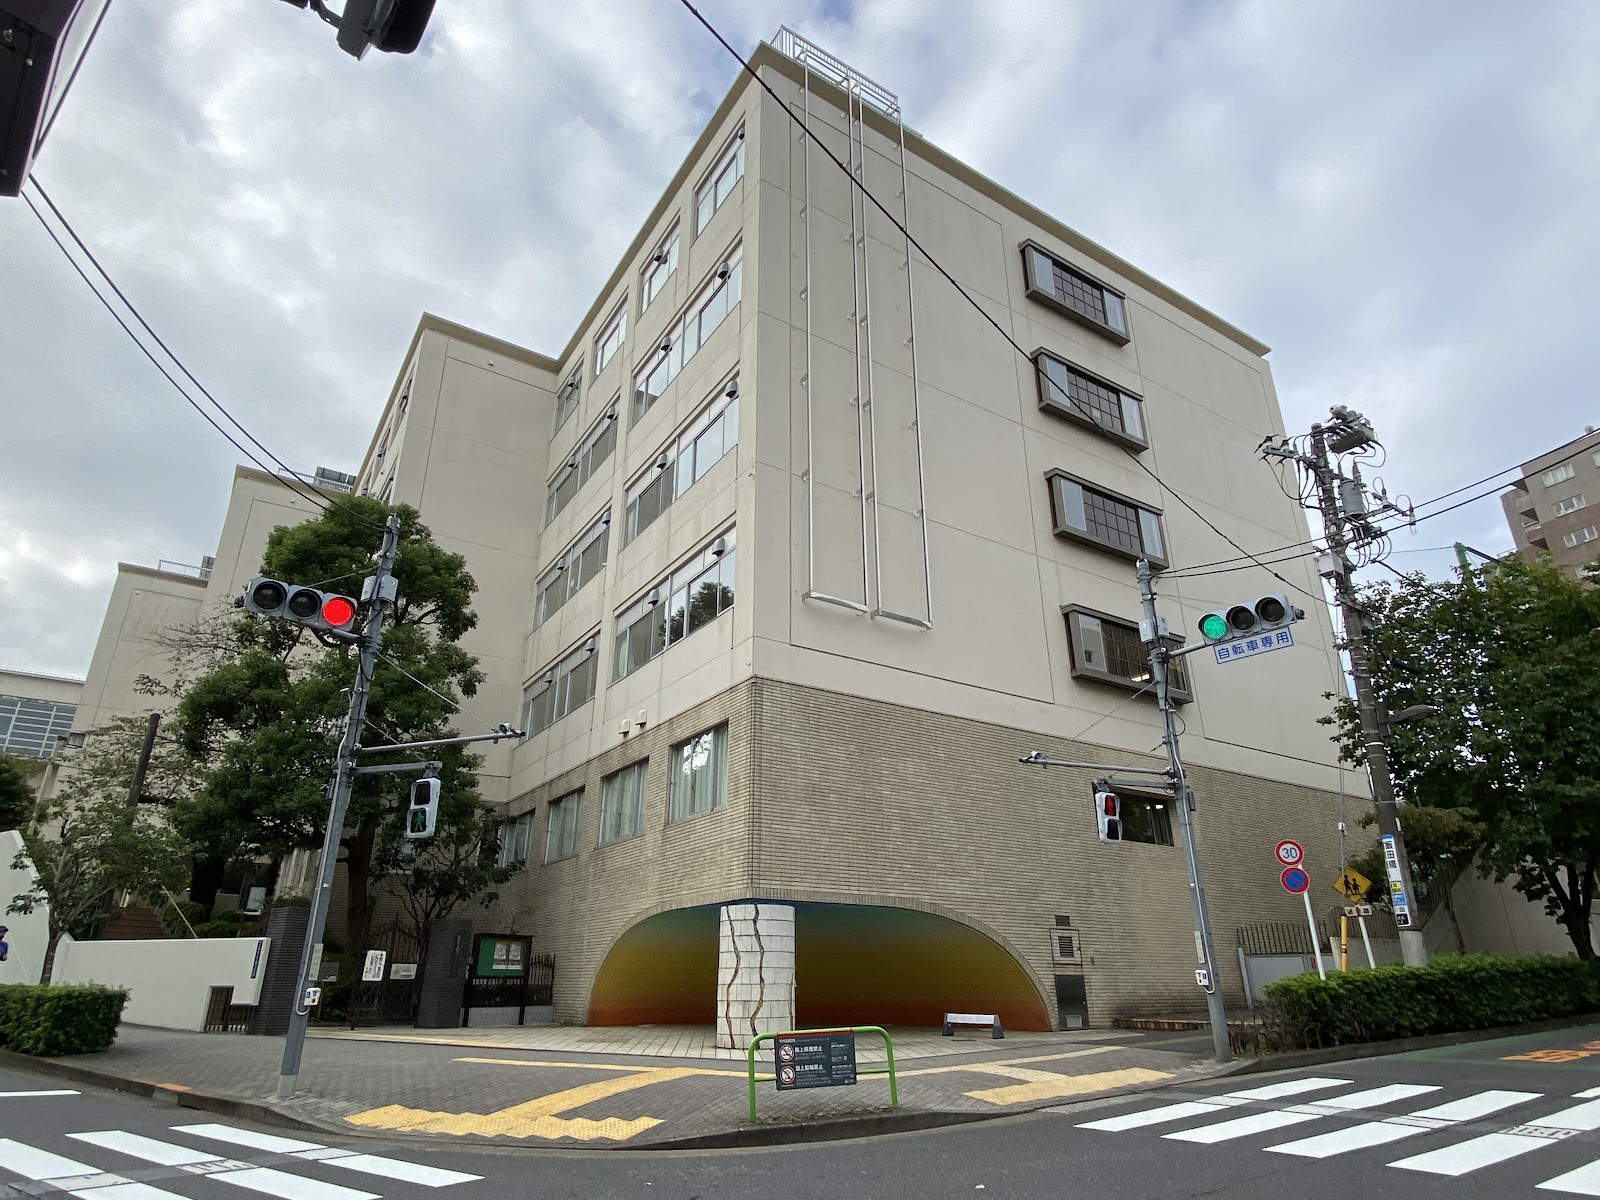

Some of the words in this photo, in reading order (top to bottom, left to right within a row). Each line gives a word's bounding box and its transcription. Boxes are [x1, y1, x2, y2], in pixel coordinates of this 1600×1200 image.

[1217, 631, 1290, 660] 自転車専用
[1282, 847, 1298, 859] 30
